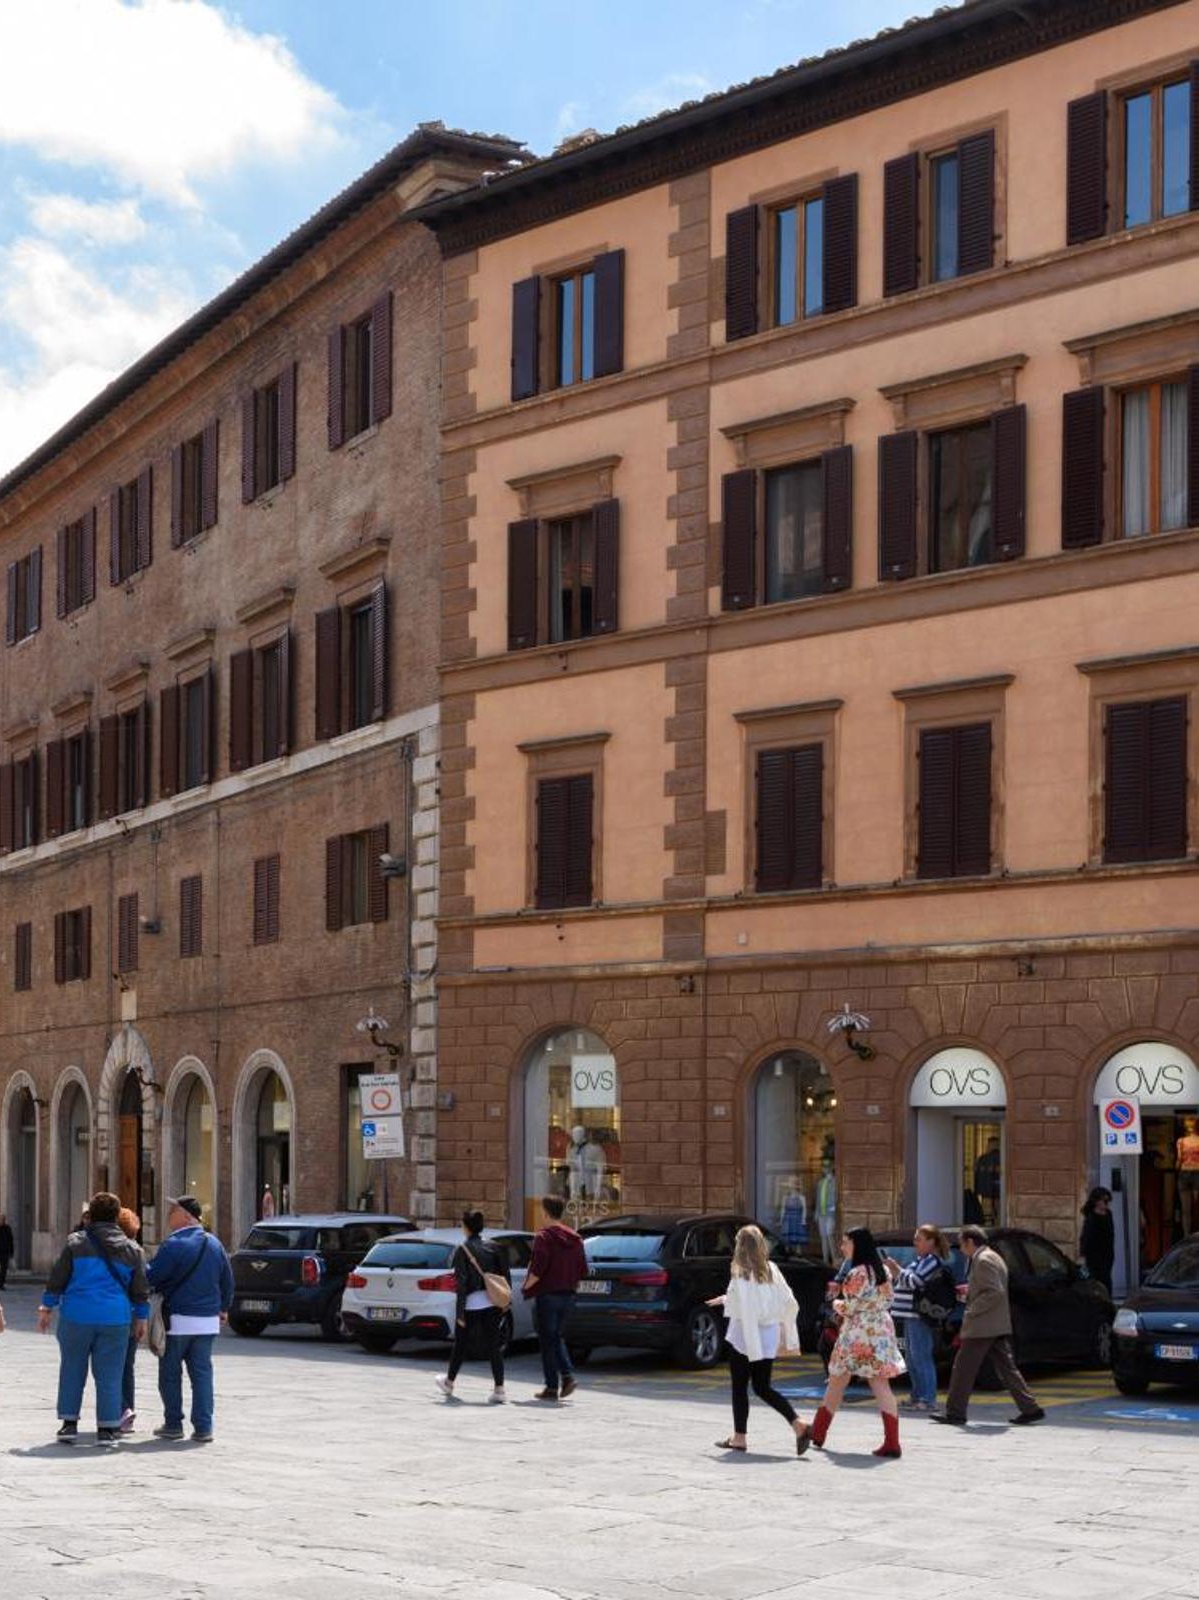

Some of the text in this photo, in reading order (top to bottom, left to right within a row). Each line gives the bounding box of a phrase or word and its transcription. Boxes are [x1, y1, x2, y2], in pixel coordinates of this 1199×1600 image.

[573, 1070, 613, 1091] OVS
[929, 1067, 991, 1096] OVS
[1115, 1064, 1184, 1096] OVS
[565, 1199, 610, 1216] ORTS
